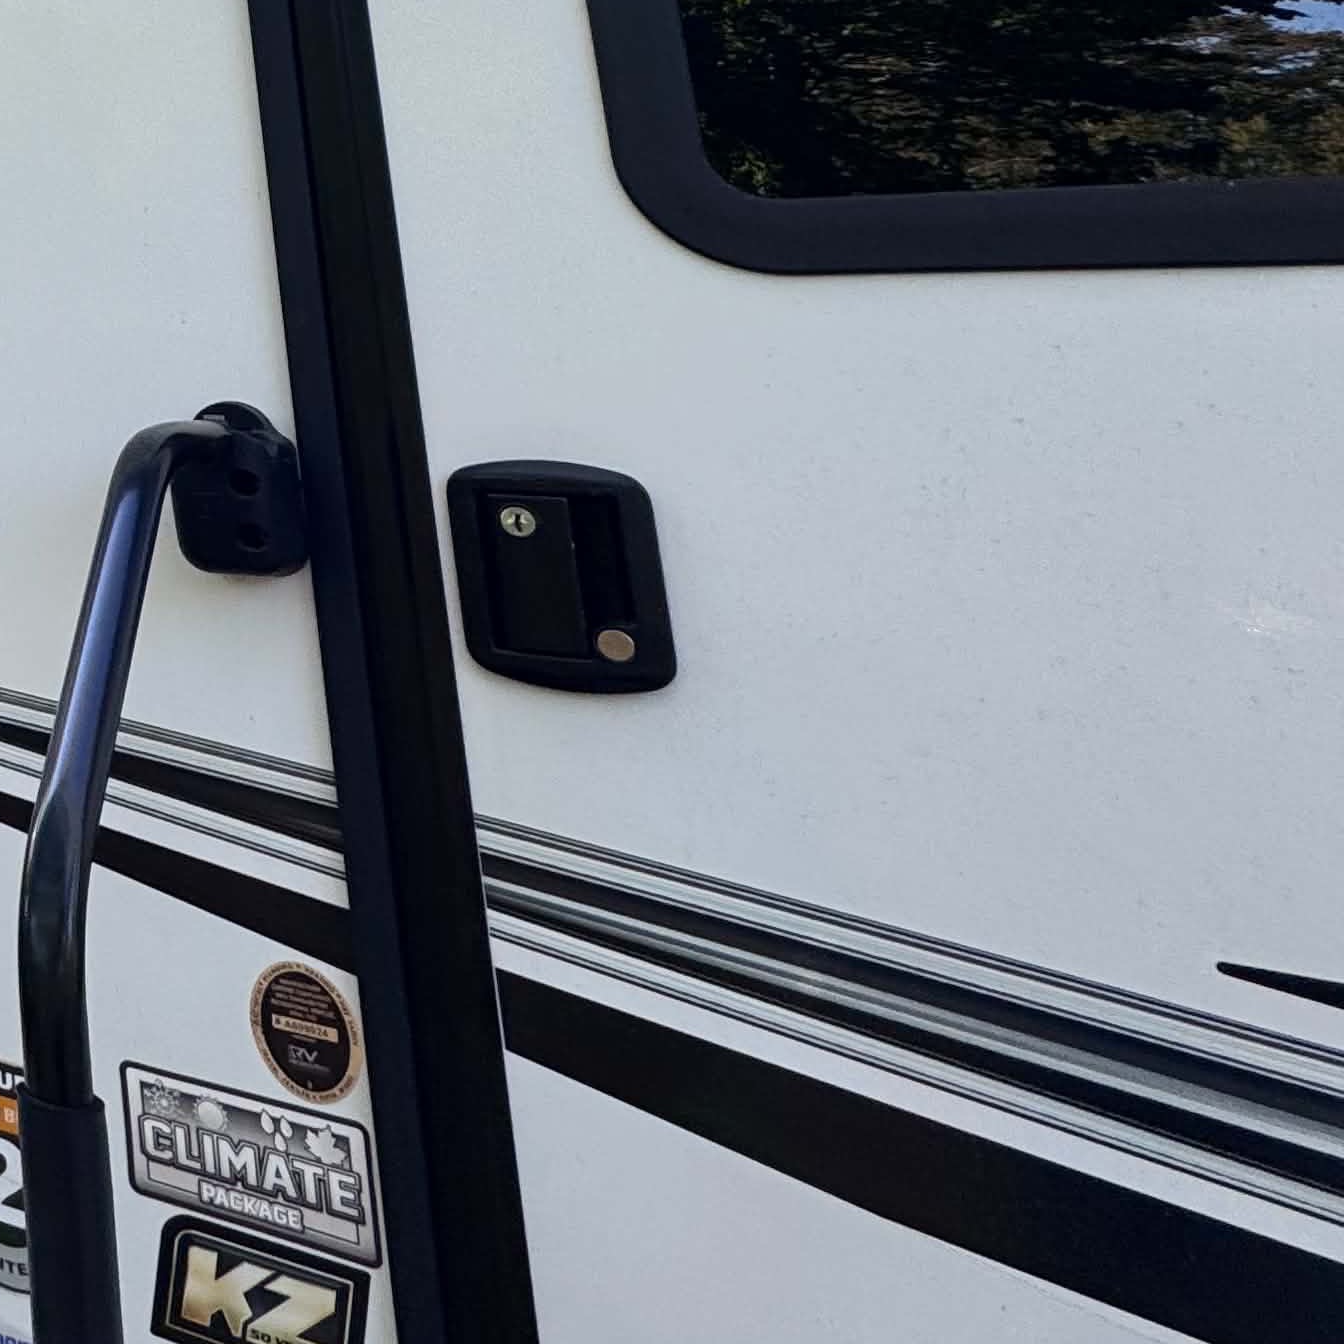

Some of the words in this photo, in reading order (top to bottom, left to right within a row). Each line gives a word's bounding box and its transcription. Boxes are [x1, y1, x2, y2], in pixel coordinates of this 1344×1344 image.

[4, 1107, 18, 1124] B
[140, 1115, 363, 1220] CLIMATE
[199, 1182, 303, 1228] PACKAGE
[181, 1245, 337, 1344] KZ
